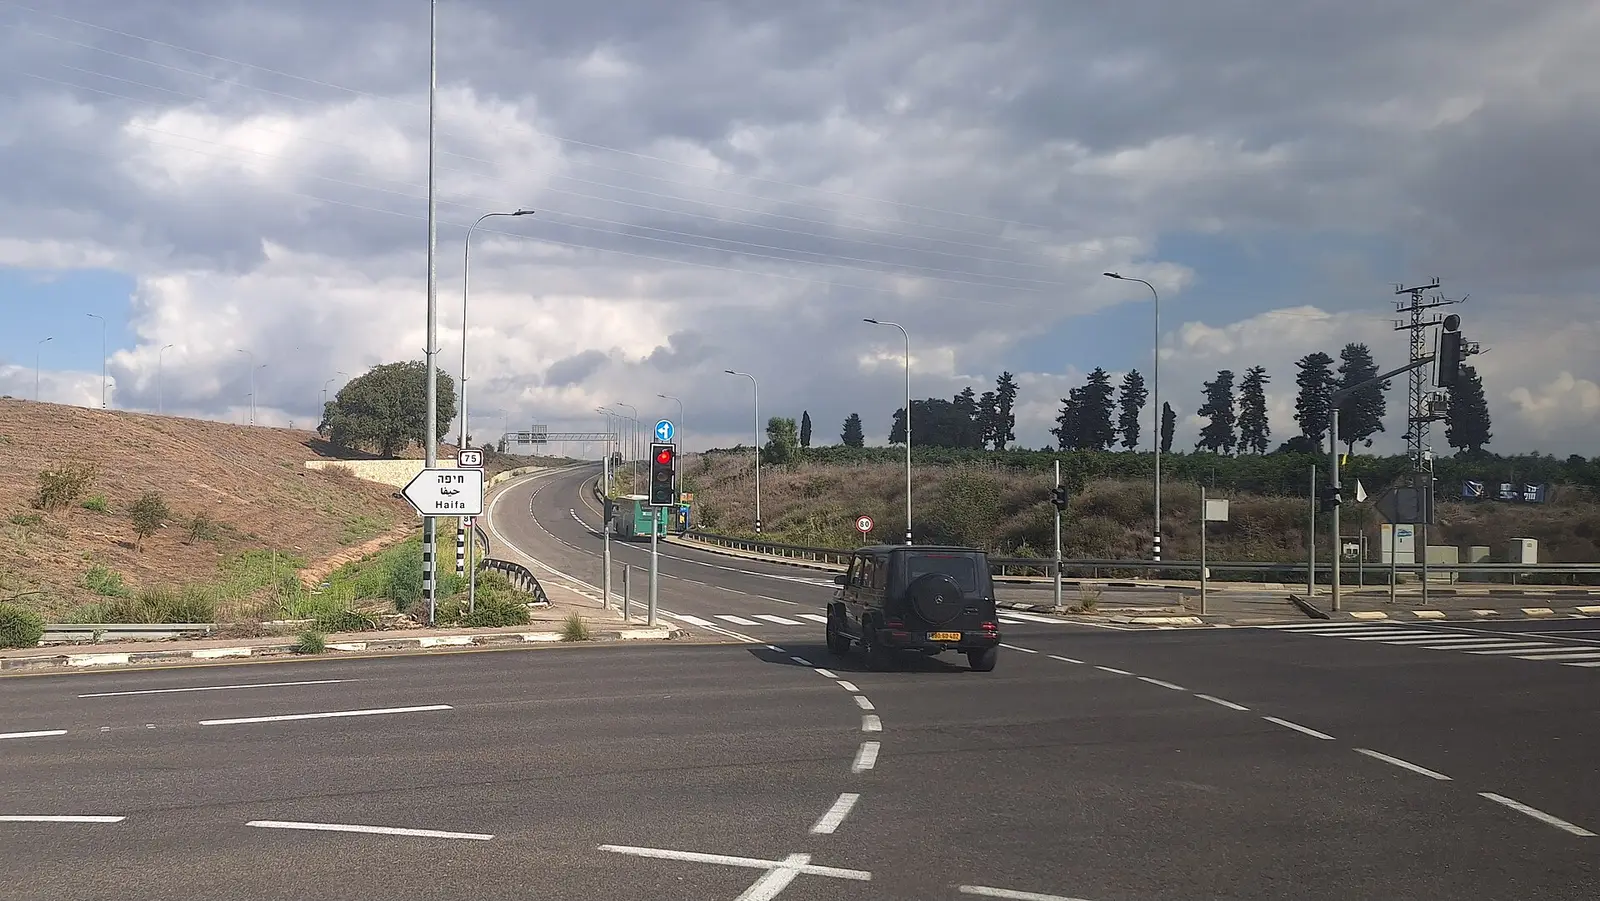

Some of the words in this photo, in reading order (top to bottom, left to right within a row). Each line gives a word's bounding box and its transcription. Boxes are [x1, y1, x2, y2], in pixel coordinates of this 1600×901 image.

[464, 454, 477, 463] 75
[437, 475, 464, 484] חיפה
[440, 487, 461, 497] حيفا
[435, 500, 466, 509] Haifa
[859, 520, 870, 528] 80
